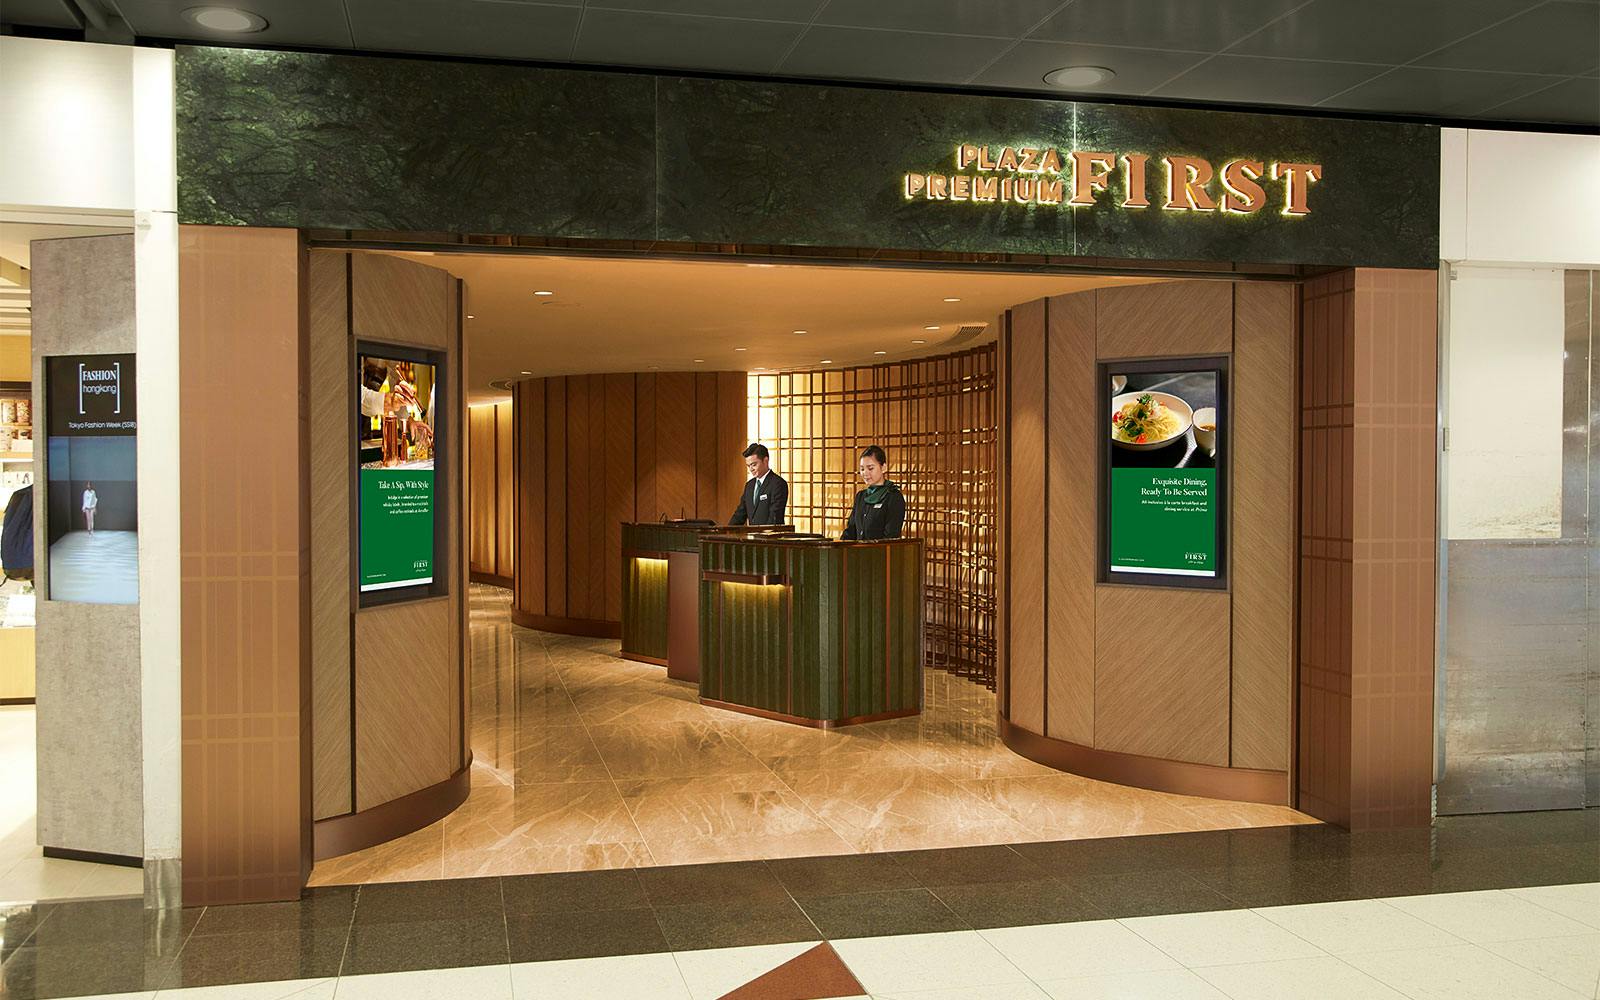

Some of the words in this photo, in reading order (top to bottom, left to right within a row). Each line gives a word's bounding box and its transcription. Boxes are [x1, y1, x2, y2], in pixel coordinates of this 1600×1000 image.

[957, 143, 1061, 173] PLAZA
[904, 173, 1063, 205] PREMIUM
[1067, 151, 1322, 216] FIRST
[82, 370, 117, 381] FASHION
[83, 384, 117, 395] hongkong
[68, 421, 84, 430] Tokyo
[84, 421, 105, 429] Fashion
[106, 421, 121, 429] Week
[378, 480, 390, 489] Take
[390, 481, 396, 489] A
[405, 480, 418, 489] With
[417, 480, 429, 491] Style
[1152, 477, 1183, 487] Exquisite
[1141, 487, 1161, 498] Ready
[1163, 488, 1172, 496] To
[1173, 488, 1183, 496] Be
[1183, 488, 1208, 497] Served
[1184, 553, 1208, 561] FIRST
